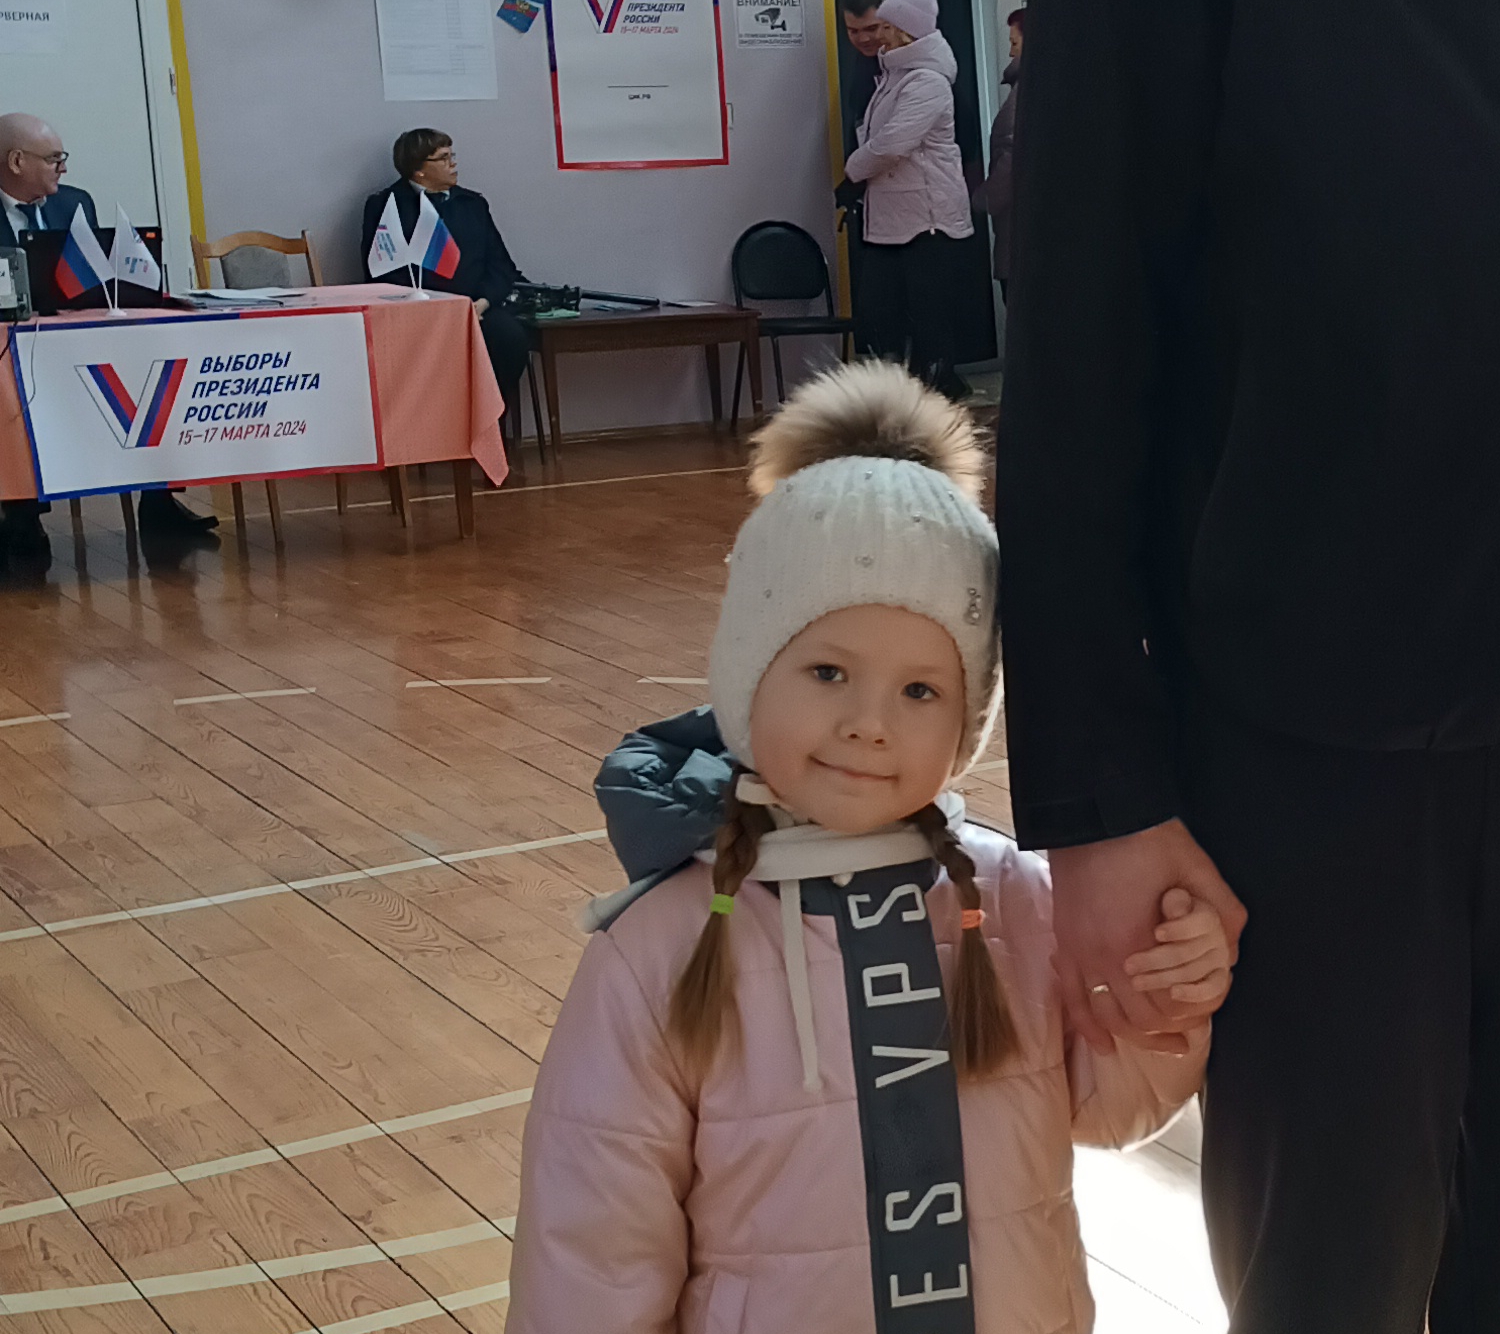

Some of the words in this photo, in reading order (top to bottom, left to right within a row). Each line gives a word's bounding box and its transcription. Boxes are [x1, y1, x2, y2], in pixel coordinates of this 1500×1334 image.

[623, 14, 661, 24] РОССИИ
[627, 2, 685, 13] ПРЕЗИДЕНТА
[200, 351, 292, 375] ВЫБОРЫ
[191, 372, 321, 399] ПРЕЗИДЕНТА
[183, 400, 269, 424] РОССИИ
[220, 423, 270, 442] МАРТА
[273, 420, 307, 438] 2024
[849, 882, 951, 1089] VPS
